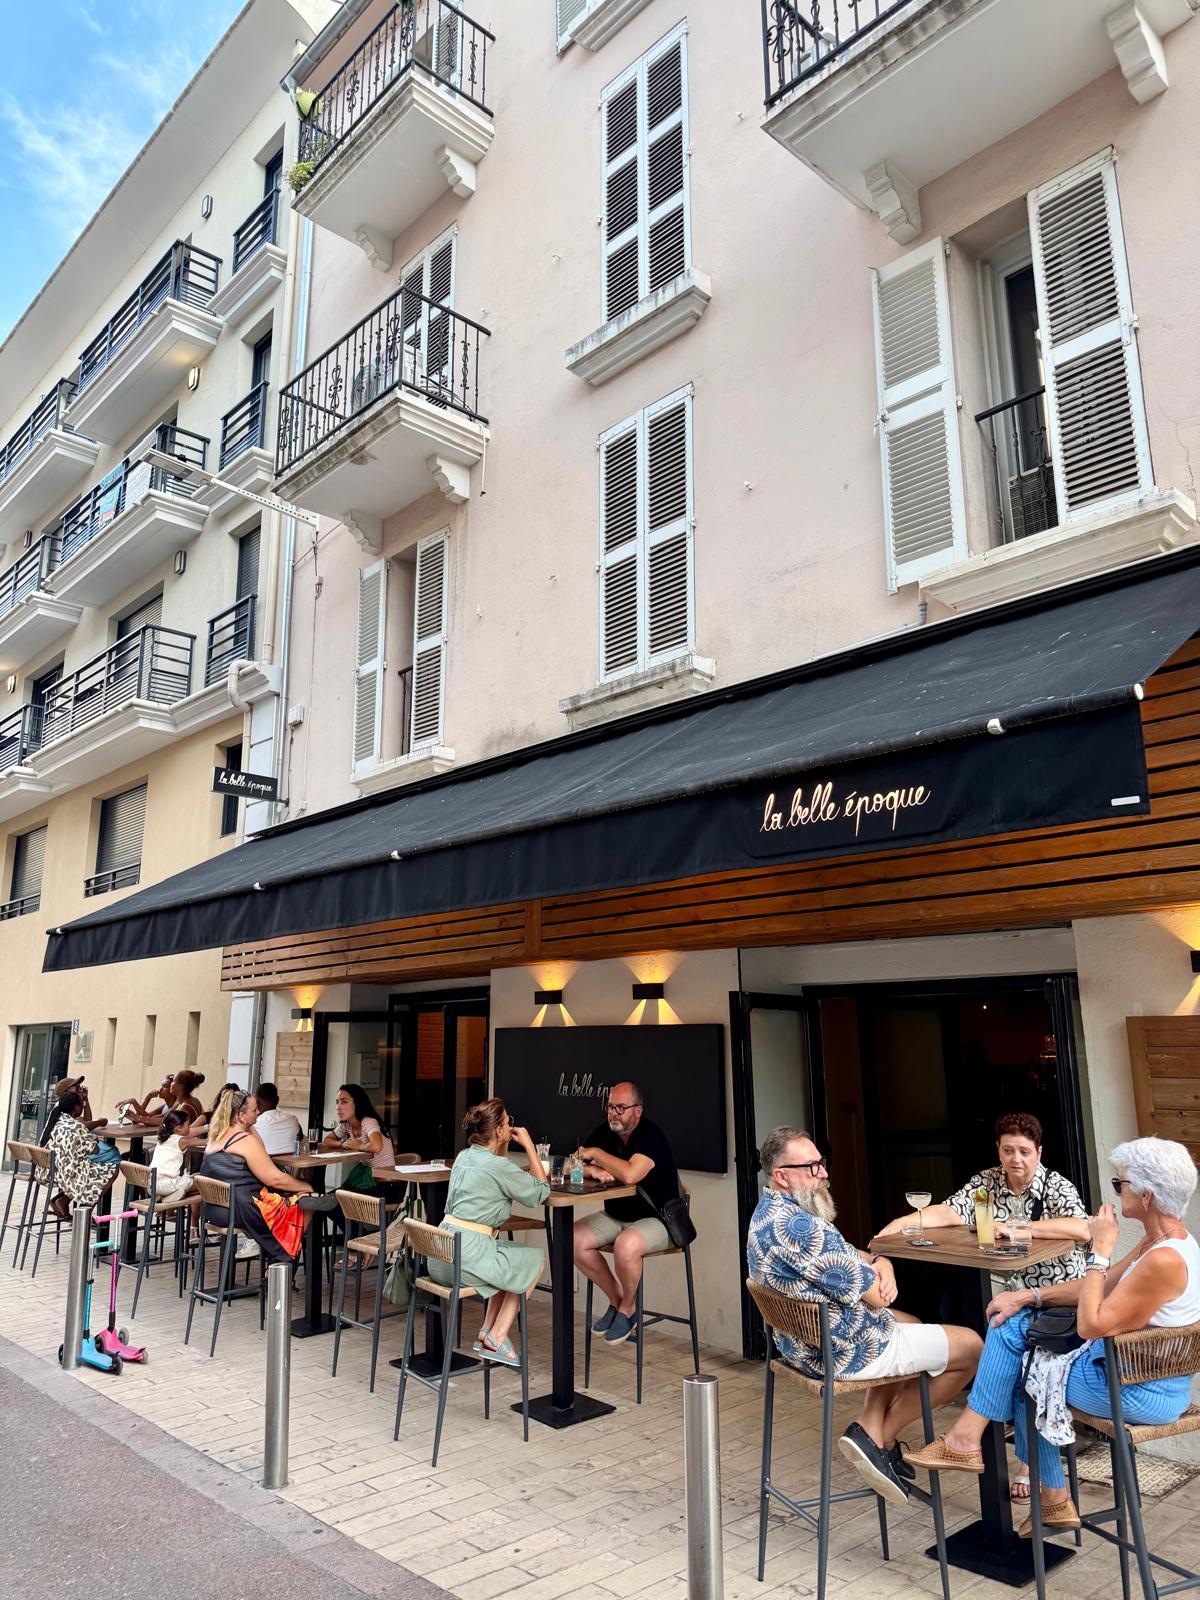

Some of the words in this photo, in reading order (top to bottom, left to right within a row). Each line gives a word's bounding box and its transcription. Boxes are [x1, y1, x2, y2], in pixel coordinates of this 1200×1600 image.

[218, 771, 228, 785] la
[228, 773, 247, 788] belle
[247, 780, 274, 796] époque
[759, 793, 784, 832] la
[786, 781, 841, 827] belle
[842, 785, 931, 837] époque
[558, 1072, 569, 1096] la
[570, 1072, 597, 1098] belle
